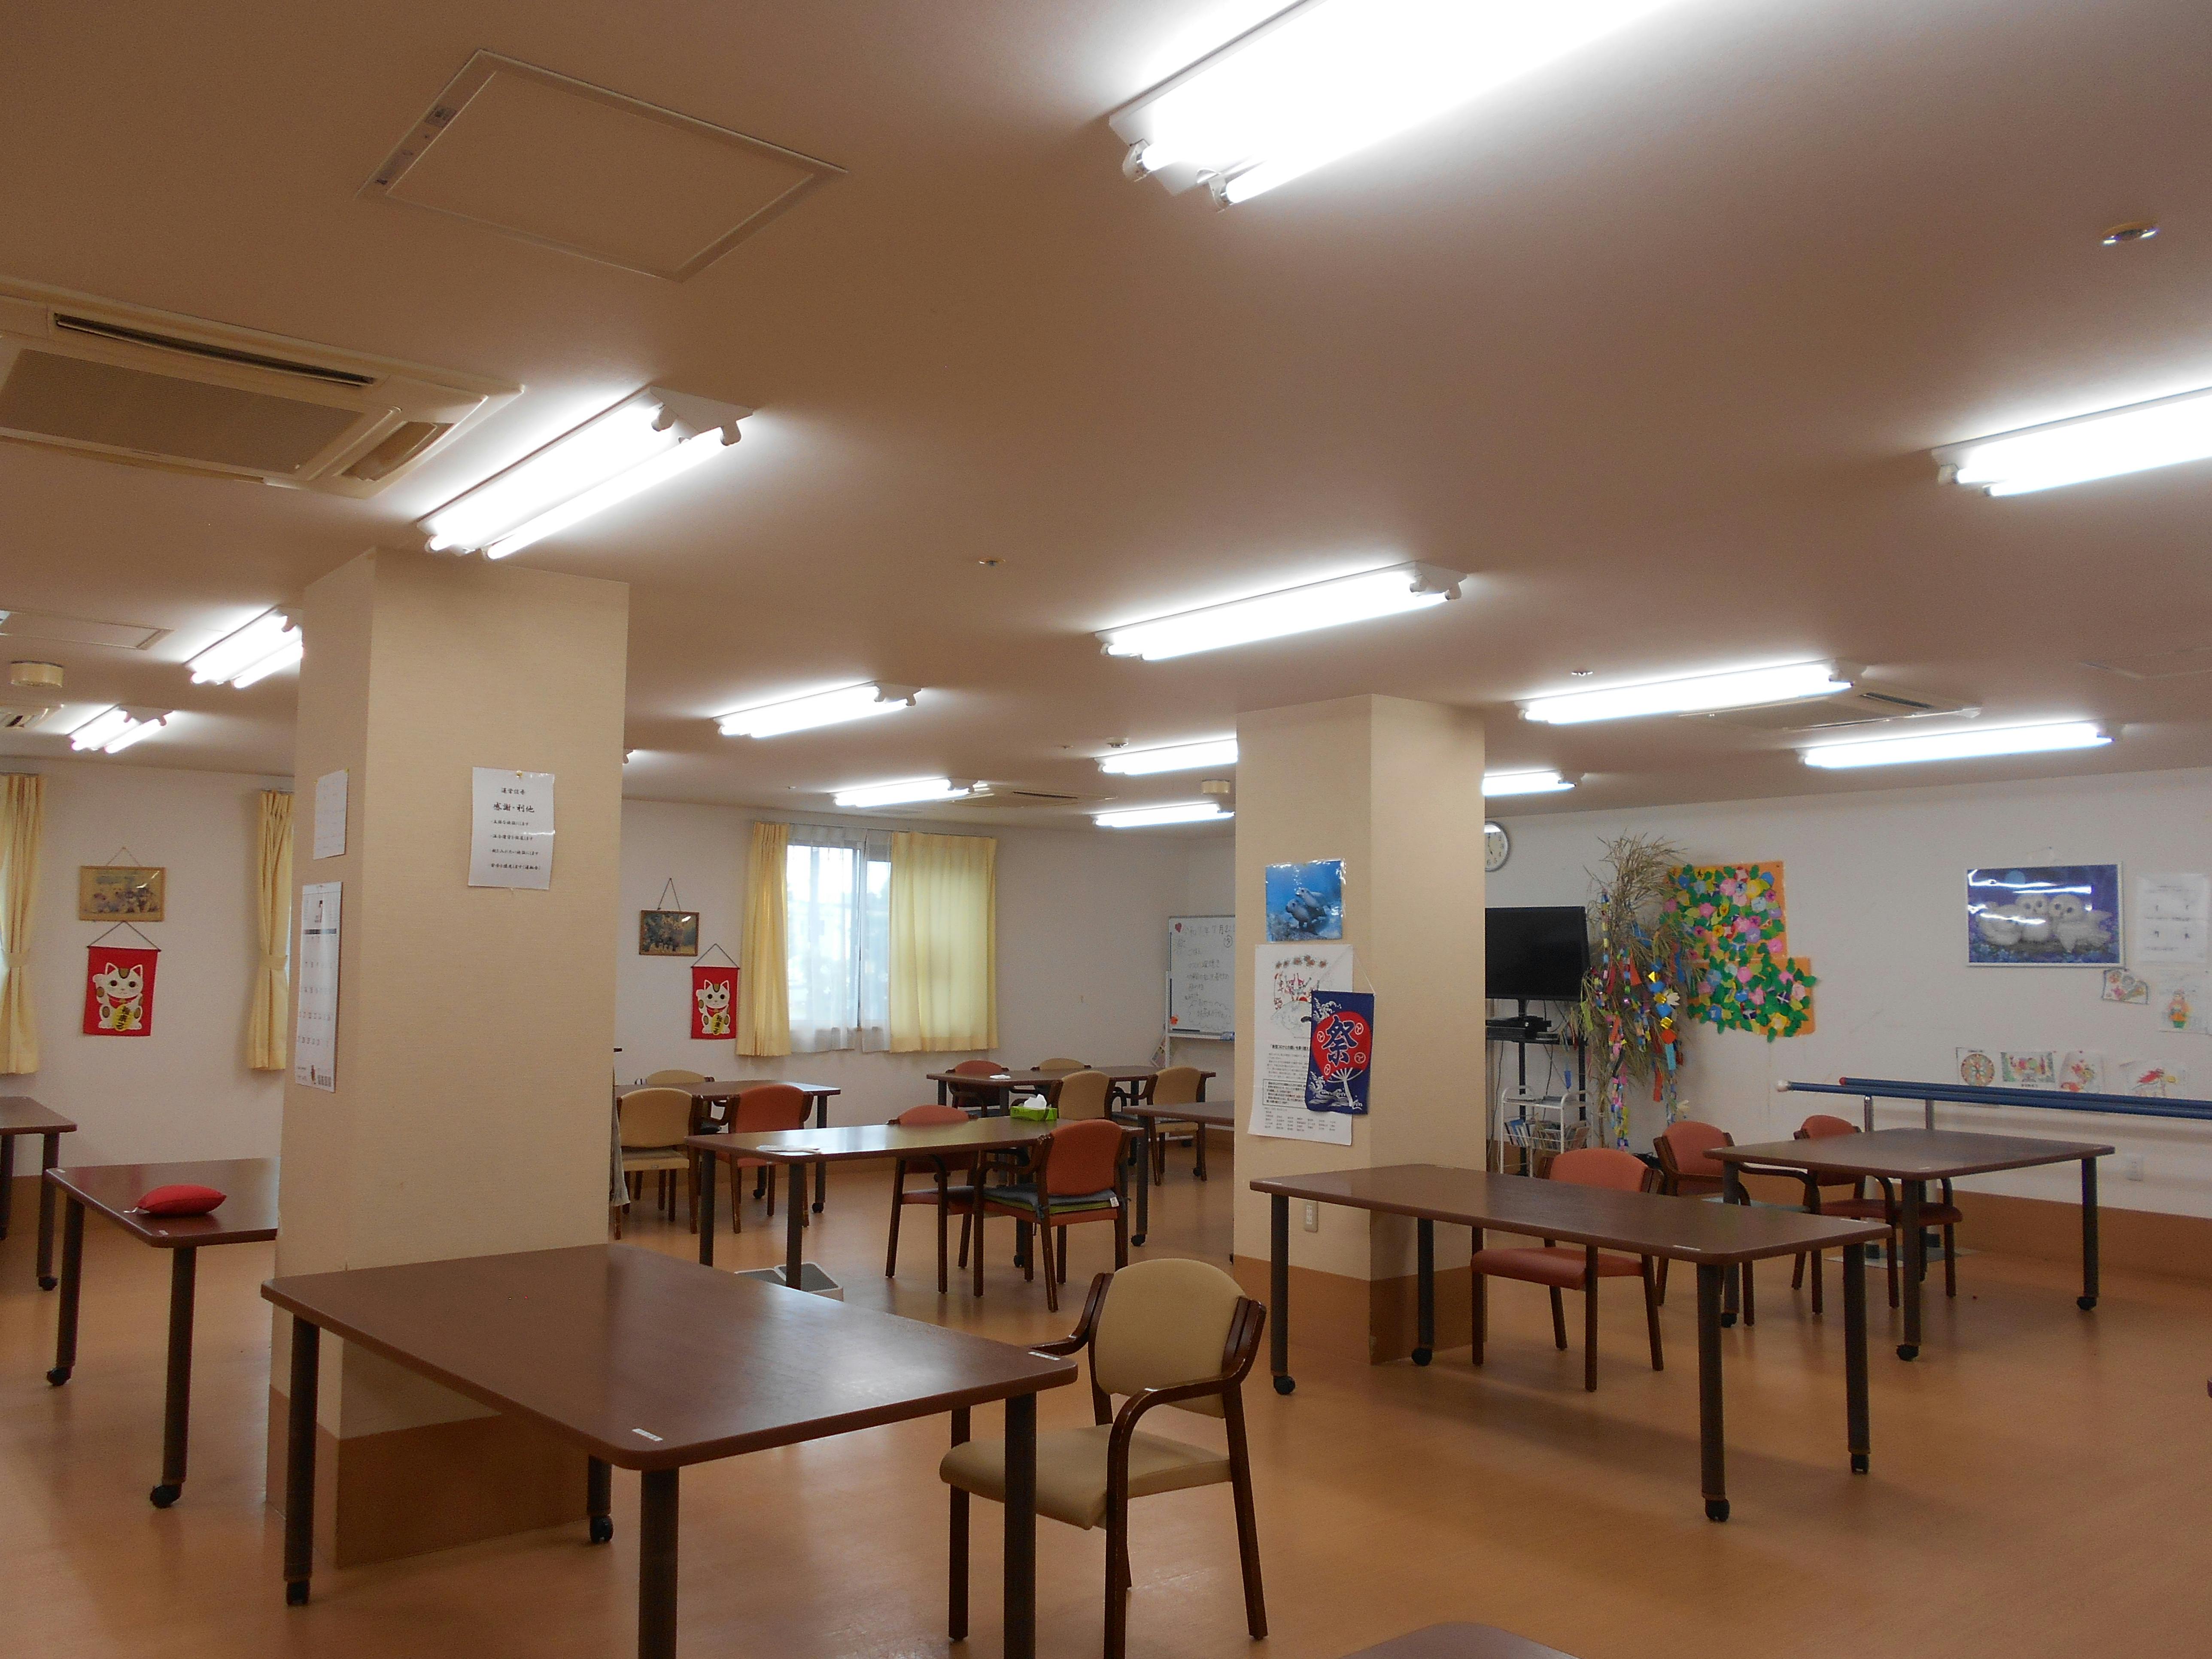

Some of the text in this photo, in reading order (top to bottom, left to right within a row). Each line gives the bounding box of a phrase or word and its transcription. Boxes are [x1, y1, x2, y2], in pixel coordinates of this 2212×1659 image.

[493, 802, 535, 813] 感謝・利他
[1322, 1015, 1358, 1067] 祭
